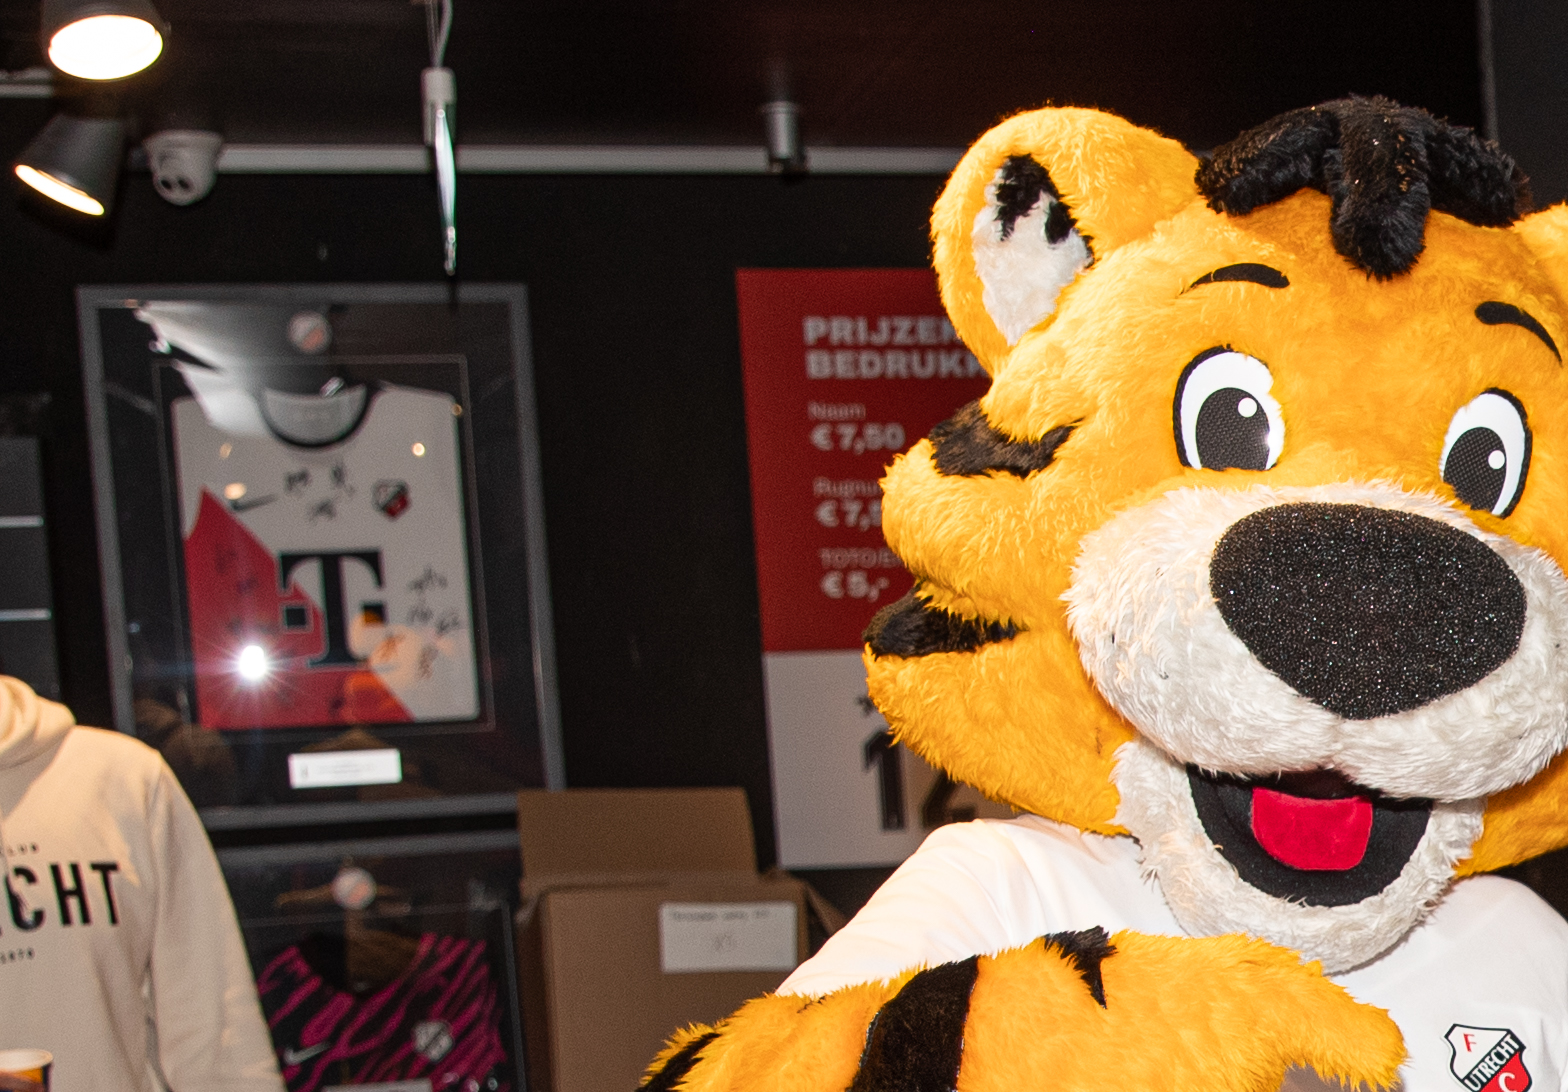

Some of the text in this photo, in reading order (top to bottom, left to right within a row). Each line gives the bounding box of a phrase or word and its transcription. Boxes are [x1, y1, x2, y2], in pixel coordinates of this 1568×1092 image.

[808, 402, 867, 421] Naam
[279, 551, 387, 667] T
[0, 861, 120, 932] CHT
[1462, 1033, 1477, 1053] F
[1463, 1033, 1520, 1092] UTRECHT
